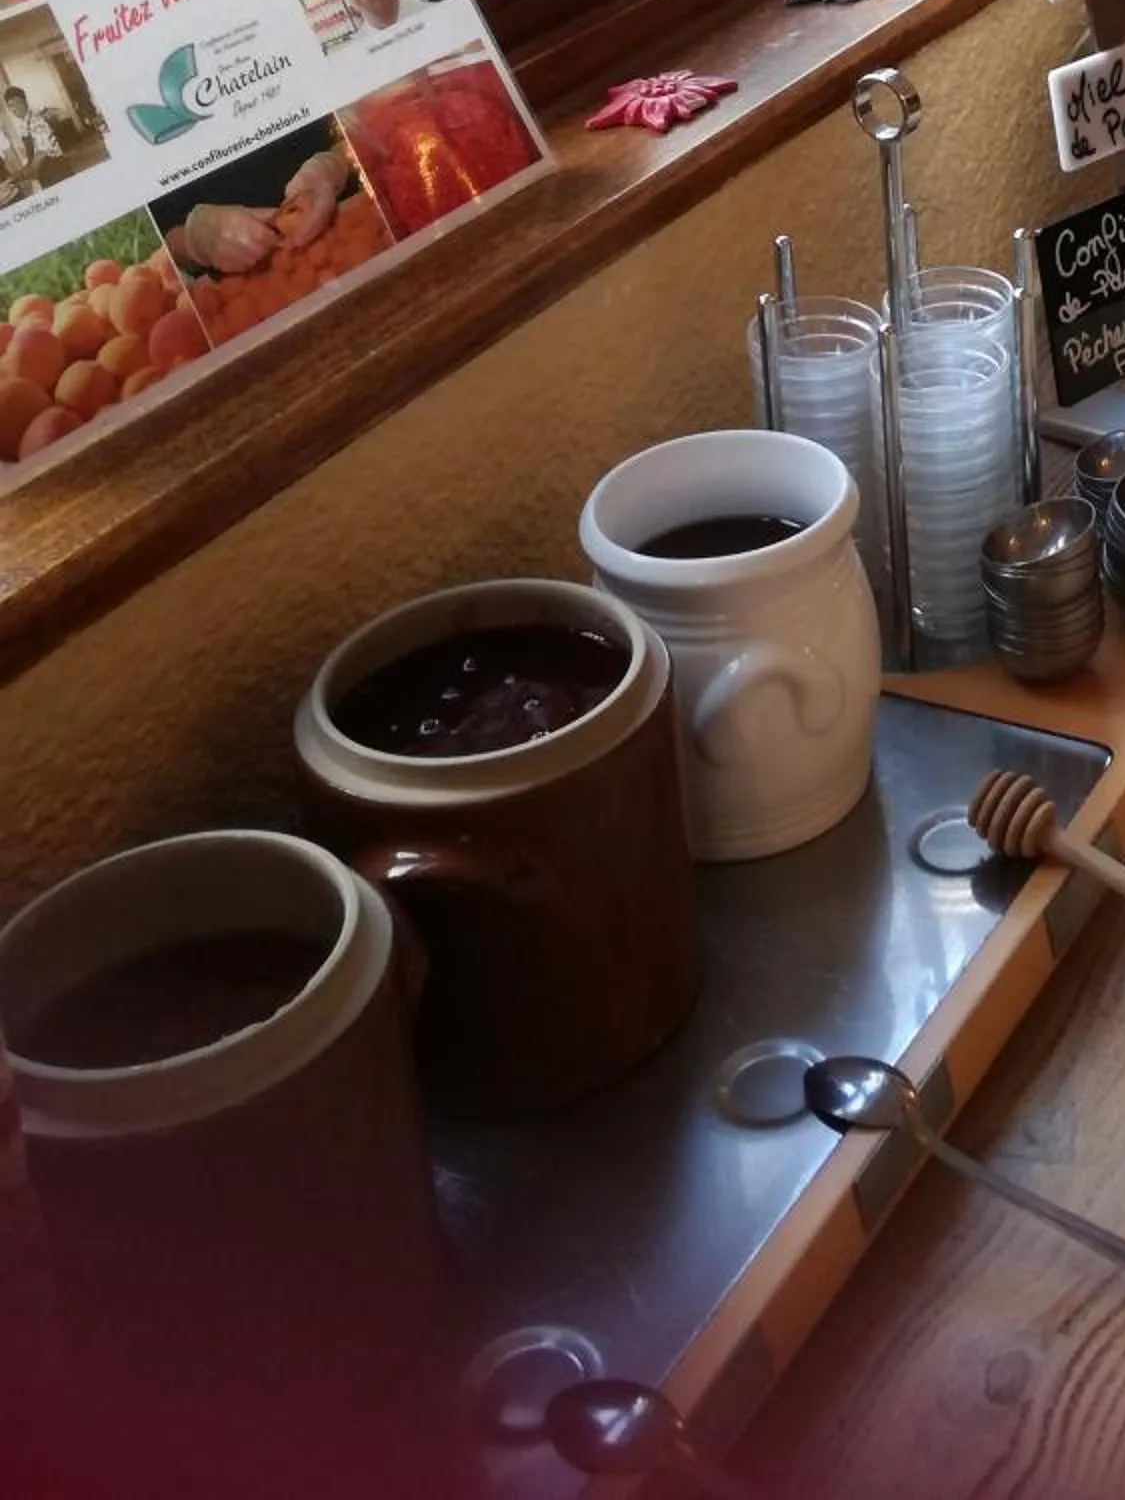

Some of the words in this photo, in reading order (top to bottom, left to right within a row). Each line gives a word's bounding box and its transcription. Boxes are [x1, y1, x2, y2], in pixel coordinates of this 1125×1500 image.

[73, 0, 154, 63] Fruitez
[195, 54, 292, 107] Chatelain
[158, 107, 311, 188] www.confiturerie-chatelain.fr
[1070, 127, 1097, 160] de
[1058, 291, 1092, 324] de
